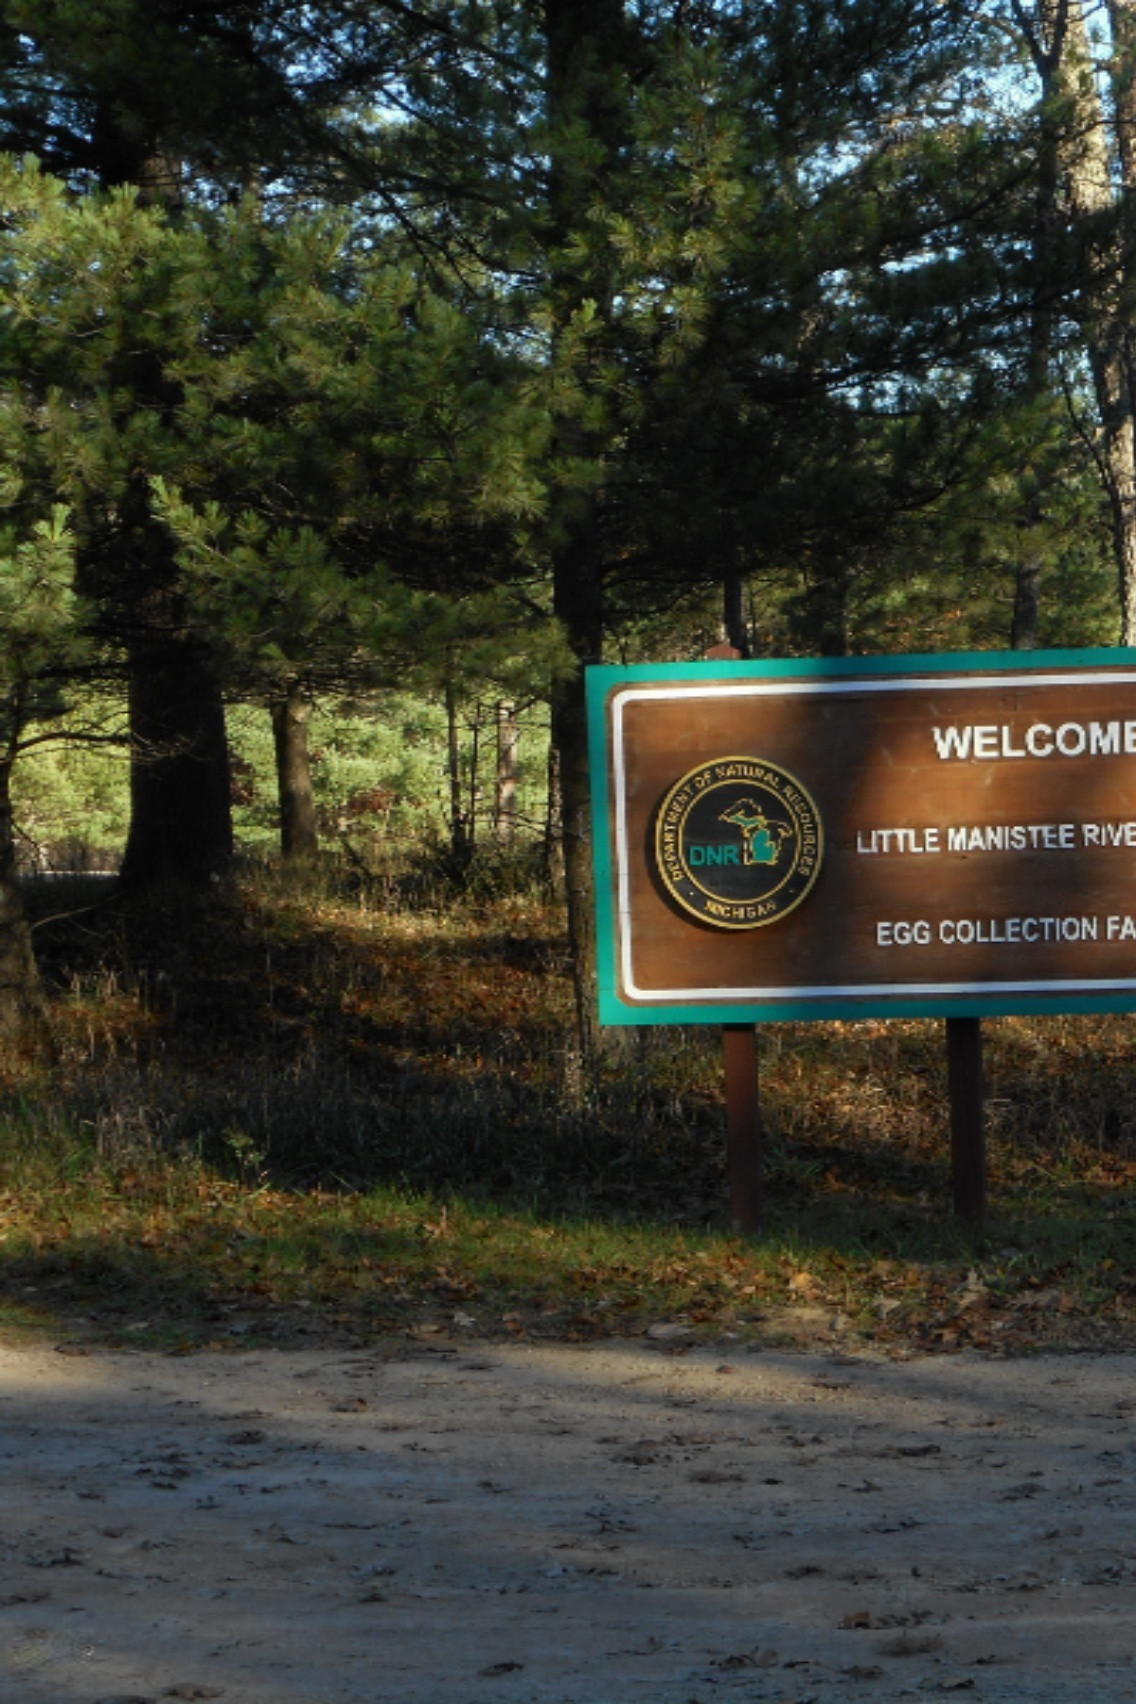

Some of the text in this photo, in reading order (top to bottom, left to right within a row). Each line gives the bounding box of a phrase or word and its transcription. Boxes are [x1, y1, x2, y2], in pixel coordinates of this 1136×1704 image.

[693, 770, 712, 788] OF
[715, 763, 782, 789] NATURAL
[782, 785, 817, 877] RESOURCES
[856, 827, 941, 855] LITTLE
[947, 824, 1075, 852] MANISTEE
[688, 844, 741, 867] DNR
[704, 901, 777, 919] MICHIGAN
[876, 920, 931, 946] EGG
[939, 916, 1098, 944] COLLECTION
